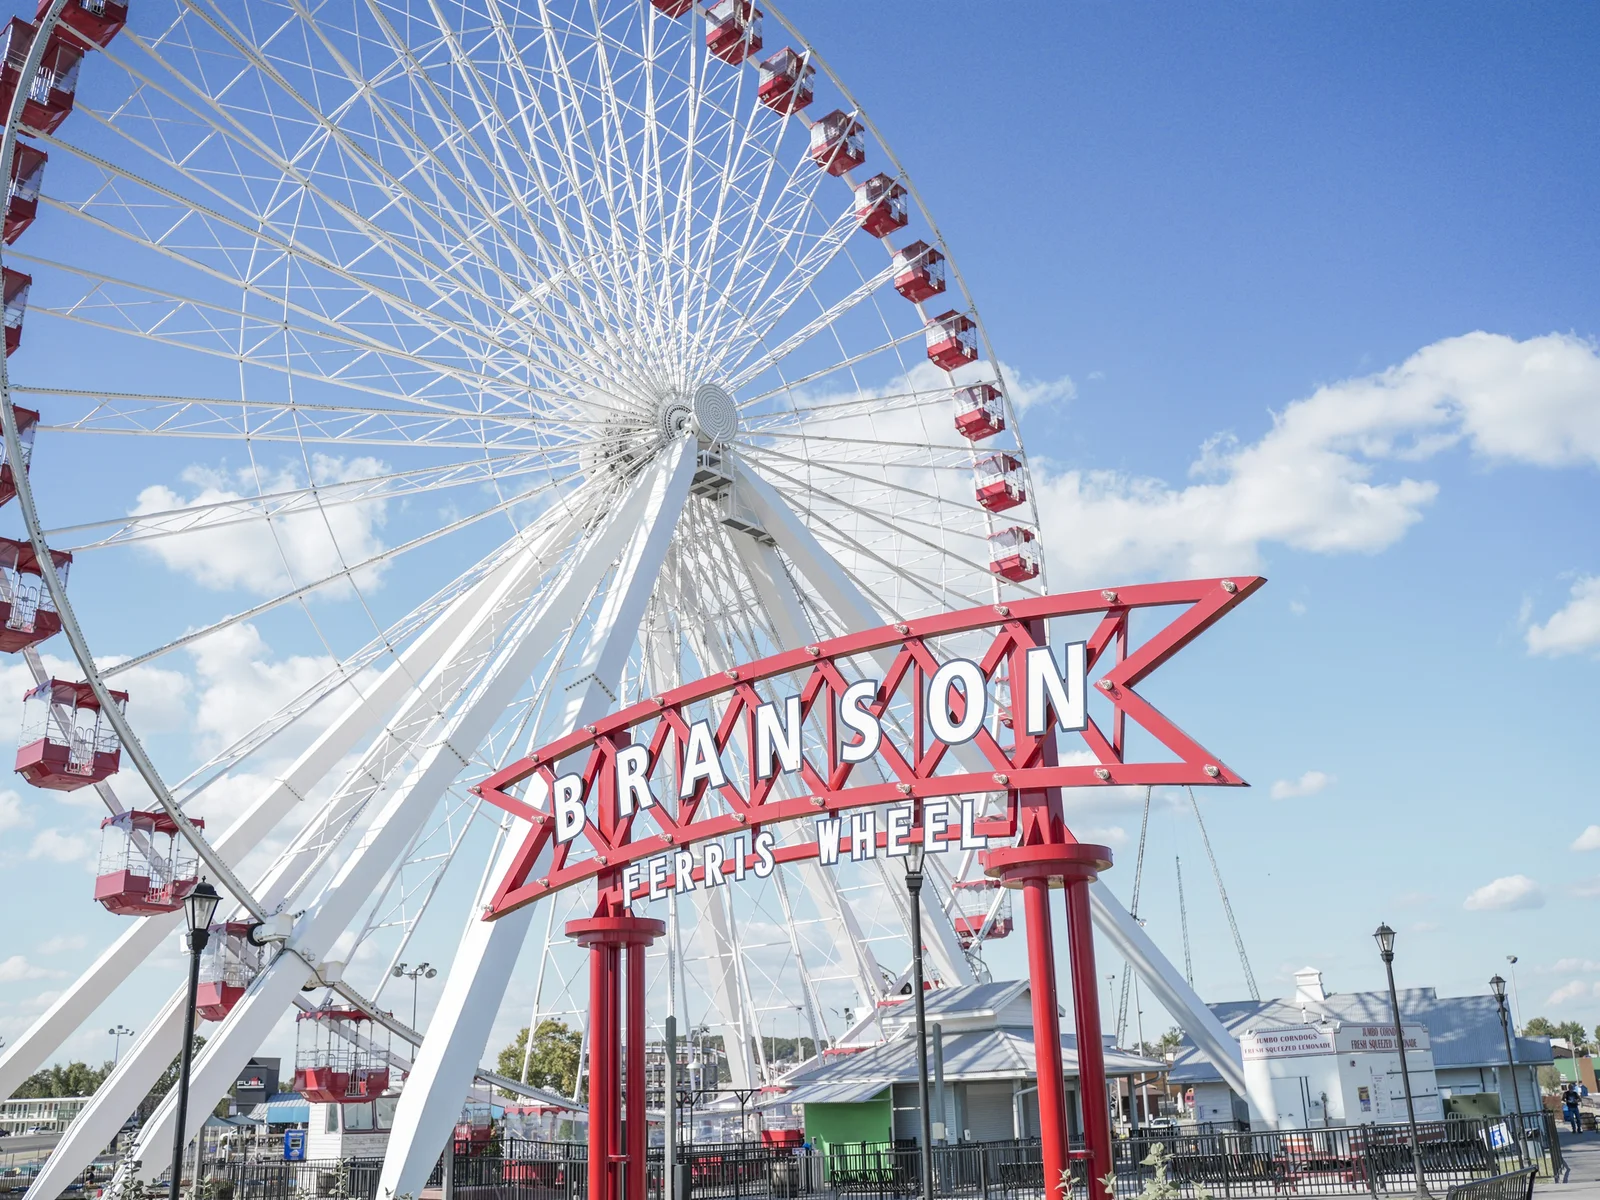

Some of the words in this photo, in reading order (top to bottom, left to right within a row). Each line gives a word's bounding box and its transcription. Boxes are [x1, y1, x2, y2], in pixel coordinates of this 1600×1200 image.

[553, 640, 1088, 844] BRANSON
[622, 831, 776, 909] FERRIS
[816, 798, 988, 866] WHEEL
[1362, 1027, 1379, 1037] JUMBO
[1380, 1027, 1405, 1037] CORNDS
[1256, 1036, 1278, 1044] JUMBO
[1280, 1034, 1318, 1042] CORNDOGS
[1351, 1040, 1368, 1050] FRESH
[1369, 1040, 1393, 1050] SQUEEZED
[1394, 1038, 1418, 1048] LONADE
[1265, 1045, 1297, 1054] SQUEEZED
[1298, 1042, 1331, 1051] LEMONADE
